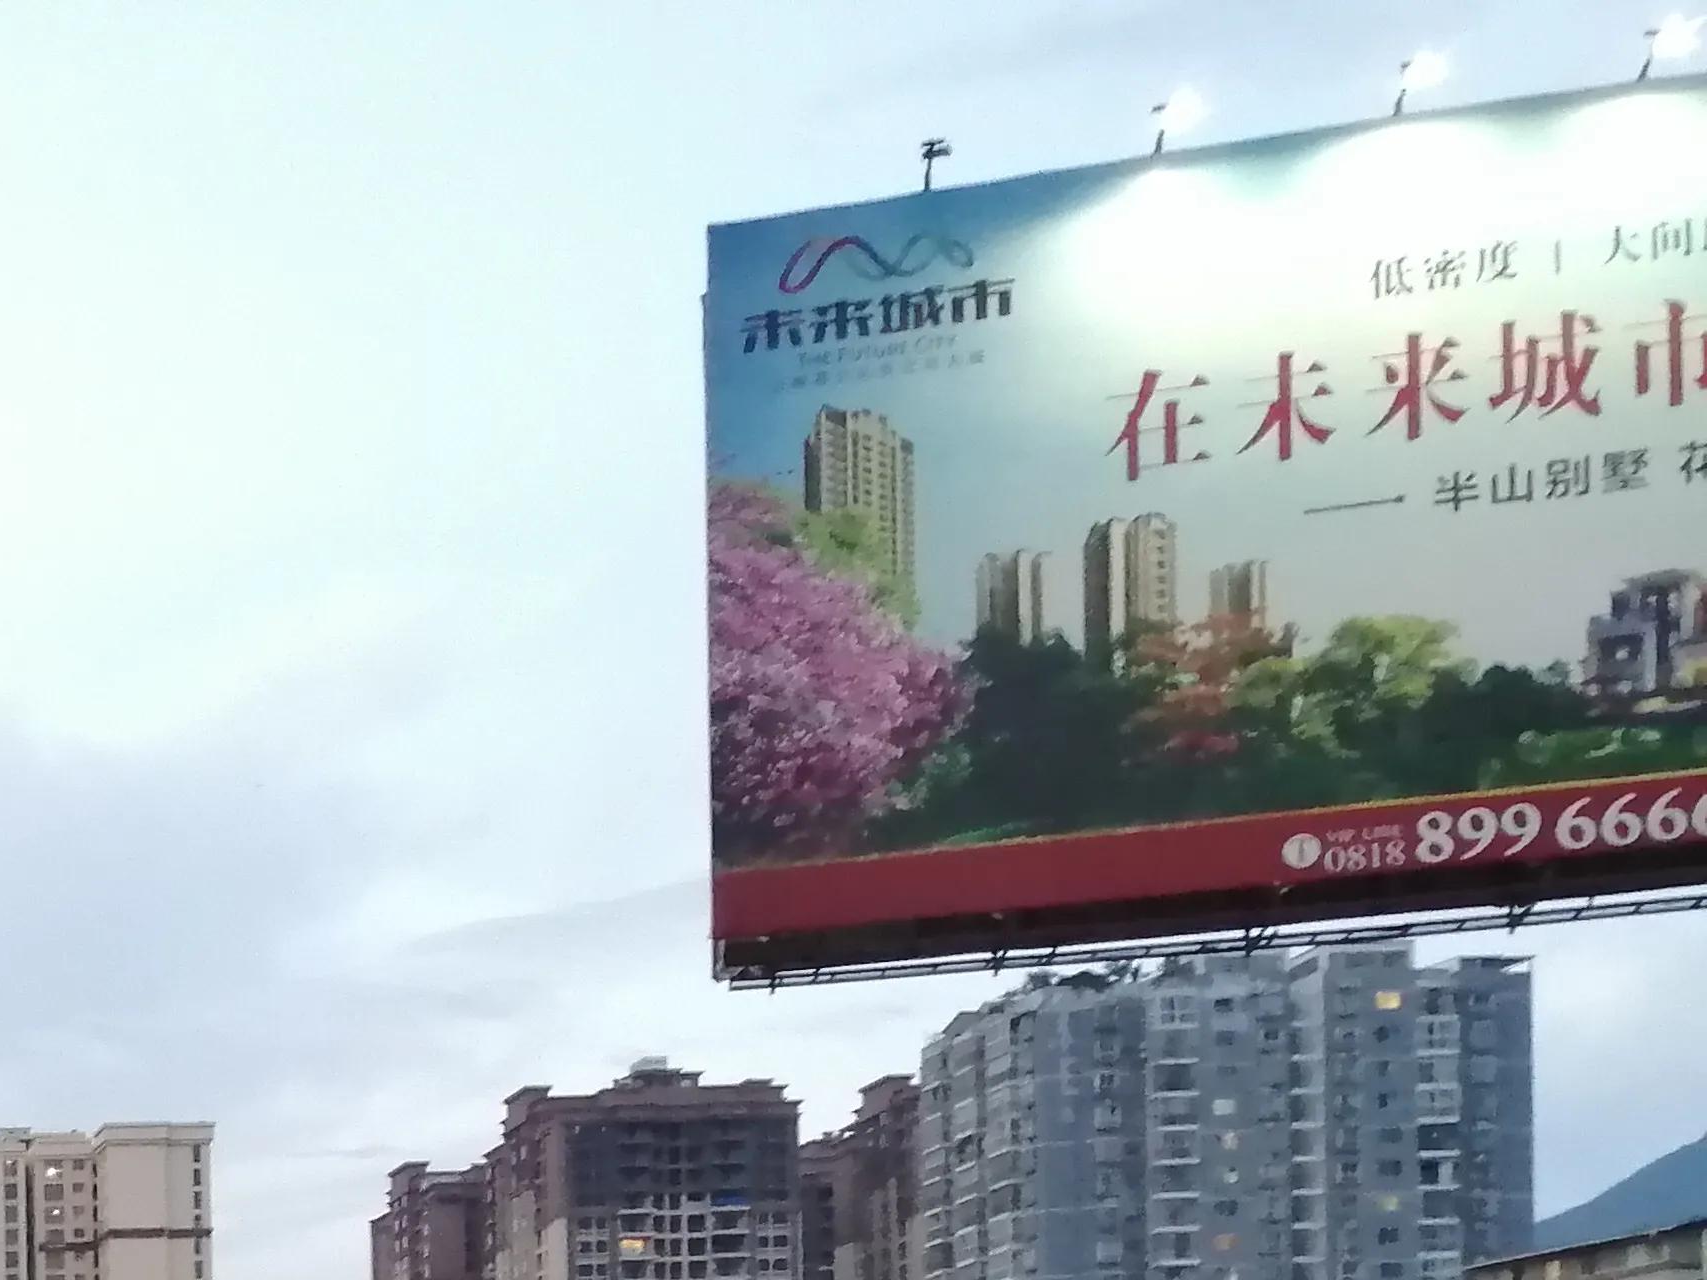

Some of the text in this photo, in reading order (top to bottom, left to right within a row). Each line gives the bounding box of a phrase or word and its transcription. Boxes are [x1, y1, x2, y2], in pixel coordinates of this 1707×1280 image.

[1371, 218, 1707, 300] 低密度 大间
[739, 279, 1015, 354] 未来城市
[1105, 299, 1707, 482] 在未来城市
[1434, 447, 1651, 512] 半山别墅
[1323, 839, 1407, 873] 0818
[1415, 801, 1543, 864] 899
